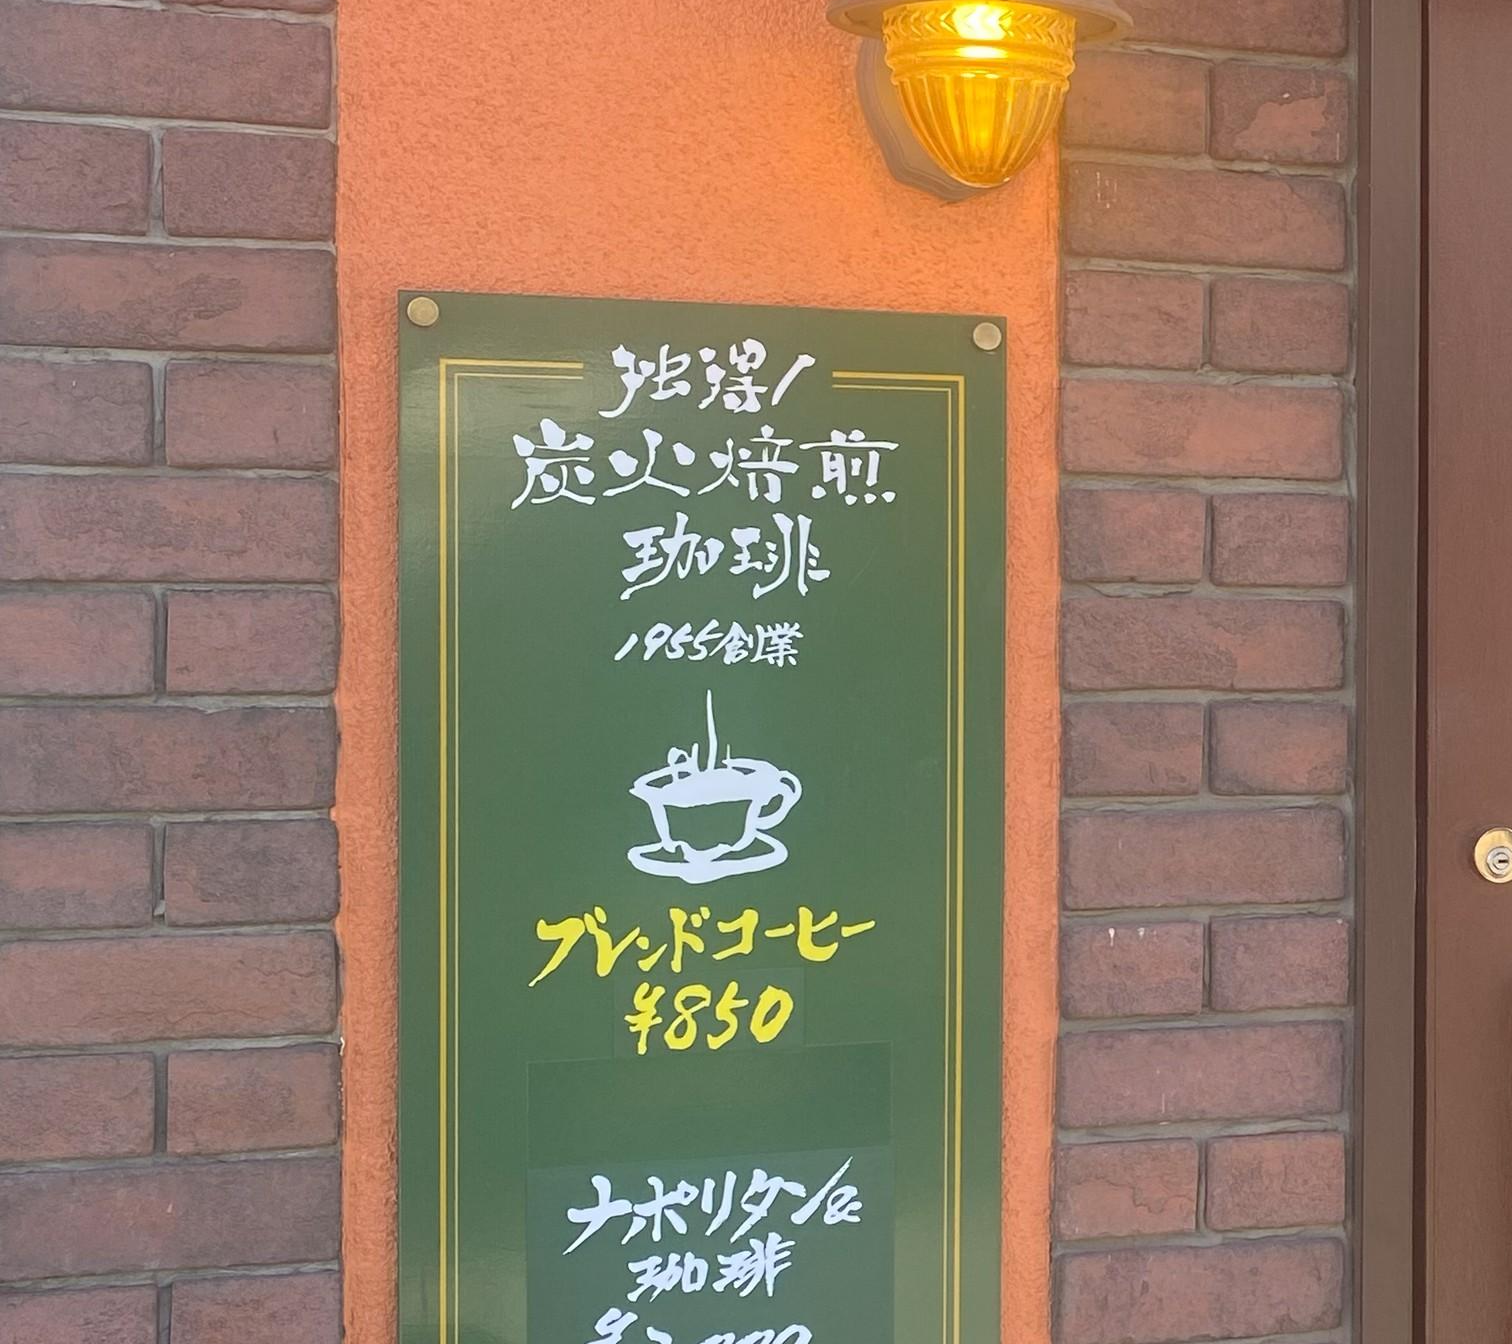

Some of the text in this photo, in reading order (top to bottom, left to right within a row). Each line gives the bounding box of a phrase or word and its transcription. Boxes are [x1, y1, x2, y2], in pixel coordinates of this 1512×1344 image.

[510, 418, 899, 509] 炭火焙煎
[620, 511, 830, 600] 珈琲
[528, 906, 876, 987] ブレンドコーヒー
[625, 982, 794, 1054] ¥850
[627, 1232, 796, 1301] 珈琲
